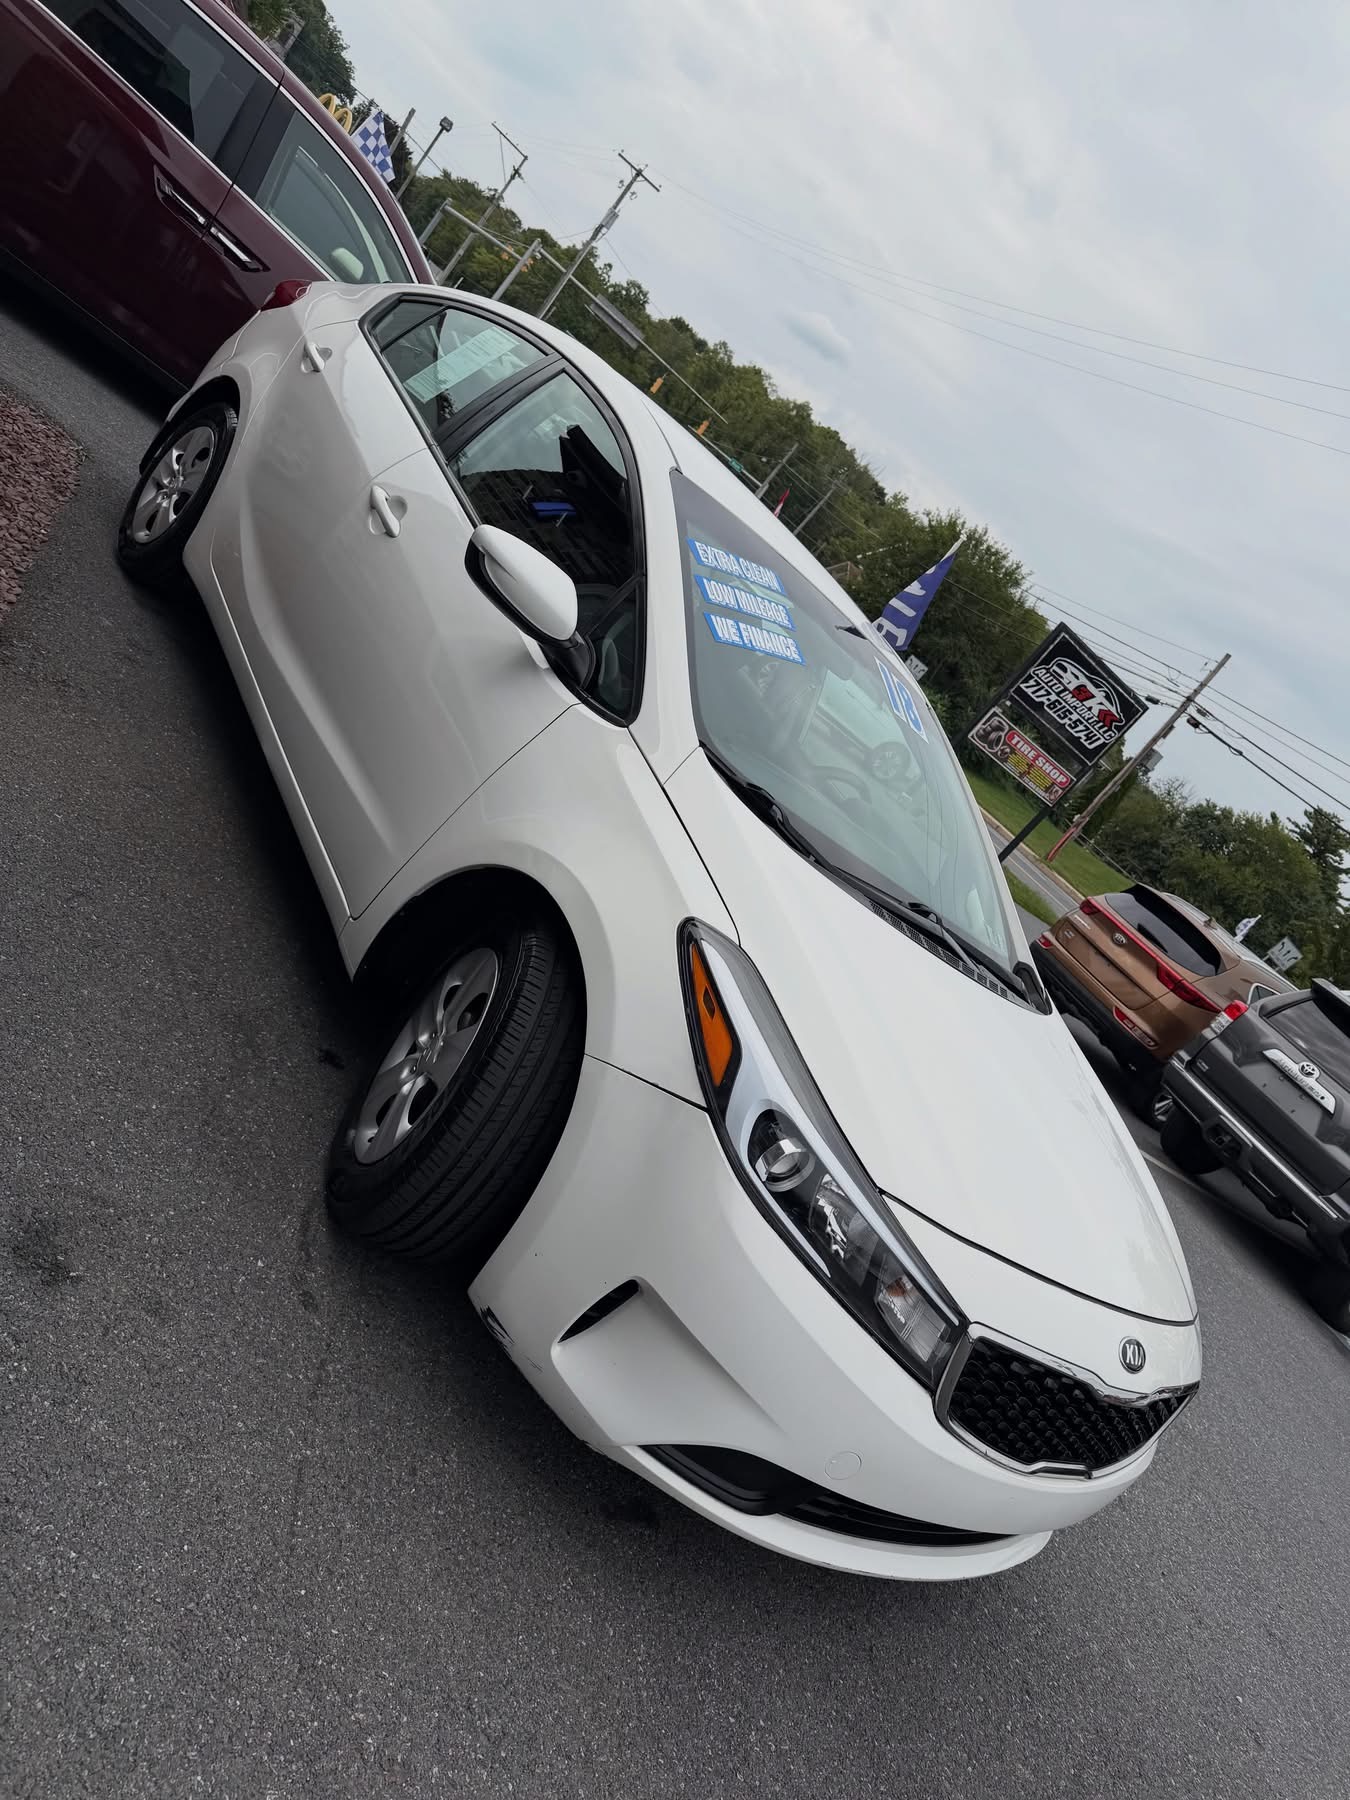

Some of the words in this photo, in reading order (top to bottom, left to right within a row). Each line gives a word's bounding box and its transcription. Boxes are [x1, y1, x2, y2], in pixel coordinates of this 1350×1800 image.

[694, 540, 743, 577] EXTRA
[738, 557, 783, 593] CLEAN
[702, 577, 739, 610] LOW
[734, 587, 793, 628] MILEAGE
[709, 613, 744, 645] WE
[738, 621, 802, 662] FINANCE
[1034, 667, 1062, 693] AUTO
[1021, 676, 1101, 747] 717-615-5741
[1011, 734, 1038, 760] TIRE
[1035, 756, 1067, 783] SHOP
